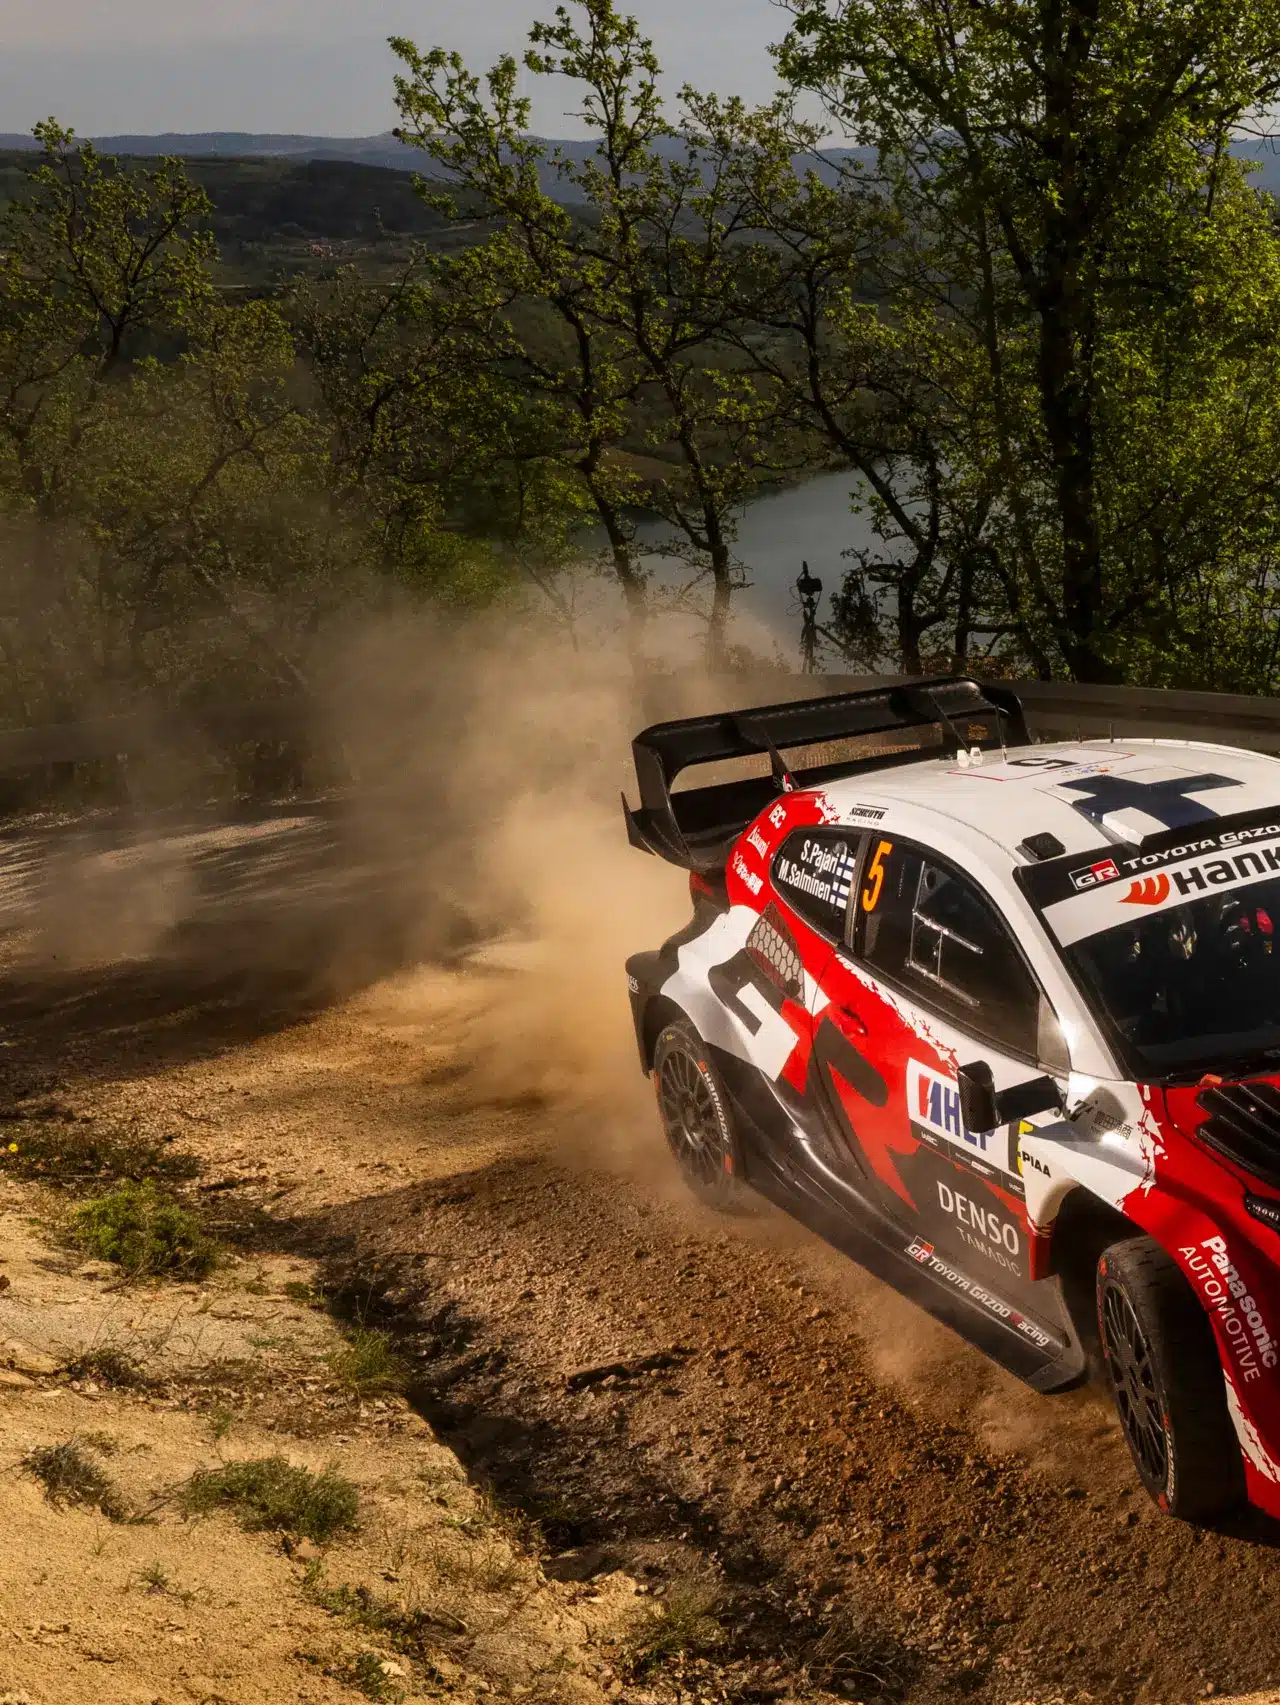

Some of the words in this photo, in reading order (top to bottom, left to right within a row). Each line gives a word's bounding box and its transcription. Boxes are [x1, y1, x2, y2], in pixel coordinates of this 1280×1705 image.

[778, 858, 832, 902] M.Salminen
[863, 840, 893, 912] 5
[1123, 840, 1215, 870] TOYOTA
[1021, 1151, 1051, 1178] PIAA
[937, 1181, 1020, 1255] DENSO
[928, 1256, 970, 1290] TOYOTA
[969, 1286, 1012, 1319] GAZOO
[1178, 1245, 1261, 1383] AUTOMOTIVE
[1201, 1235, 1278, 1369] Panasonic
